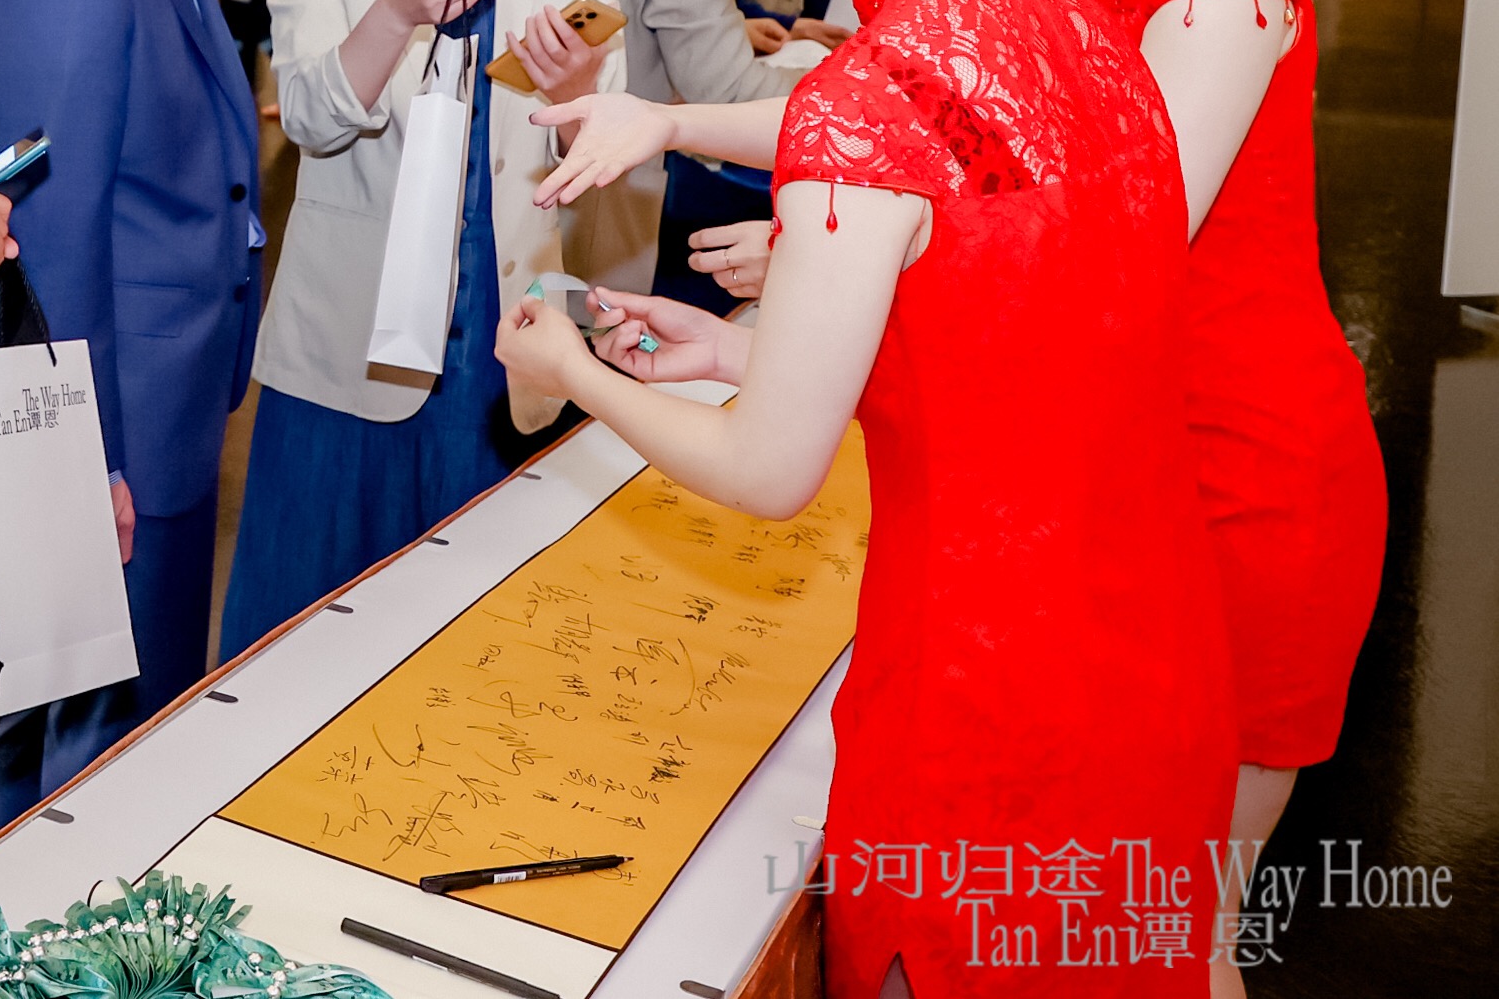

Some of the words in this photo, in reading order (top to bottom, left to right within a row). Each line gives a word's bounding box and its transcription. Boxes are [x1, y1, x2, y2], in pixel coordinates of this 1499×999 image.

[22, 388, 40, 412] The
[40, 385, 60, 416] Way
[61, 383, 87, 407] Home
